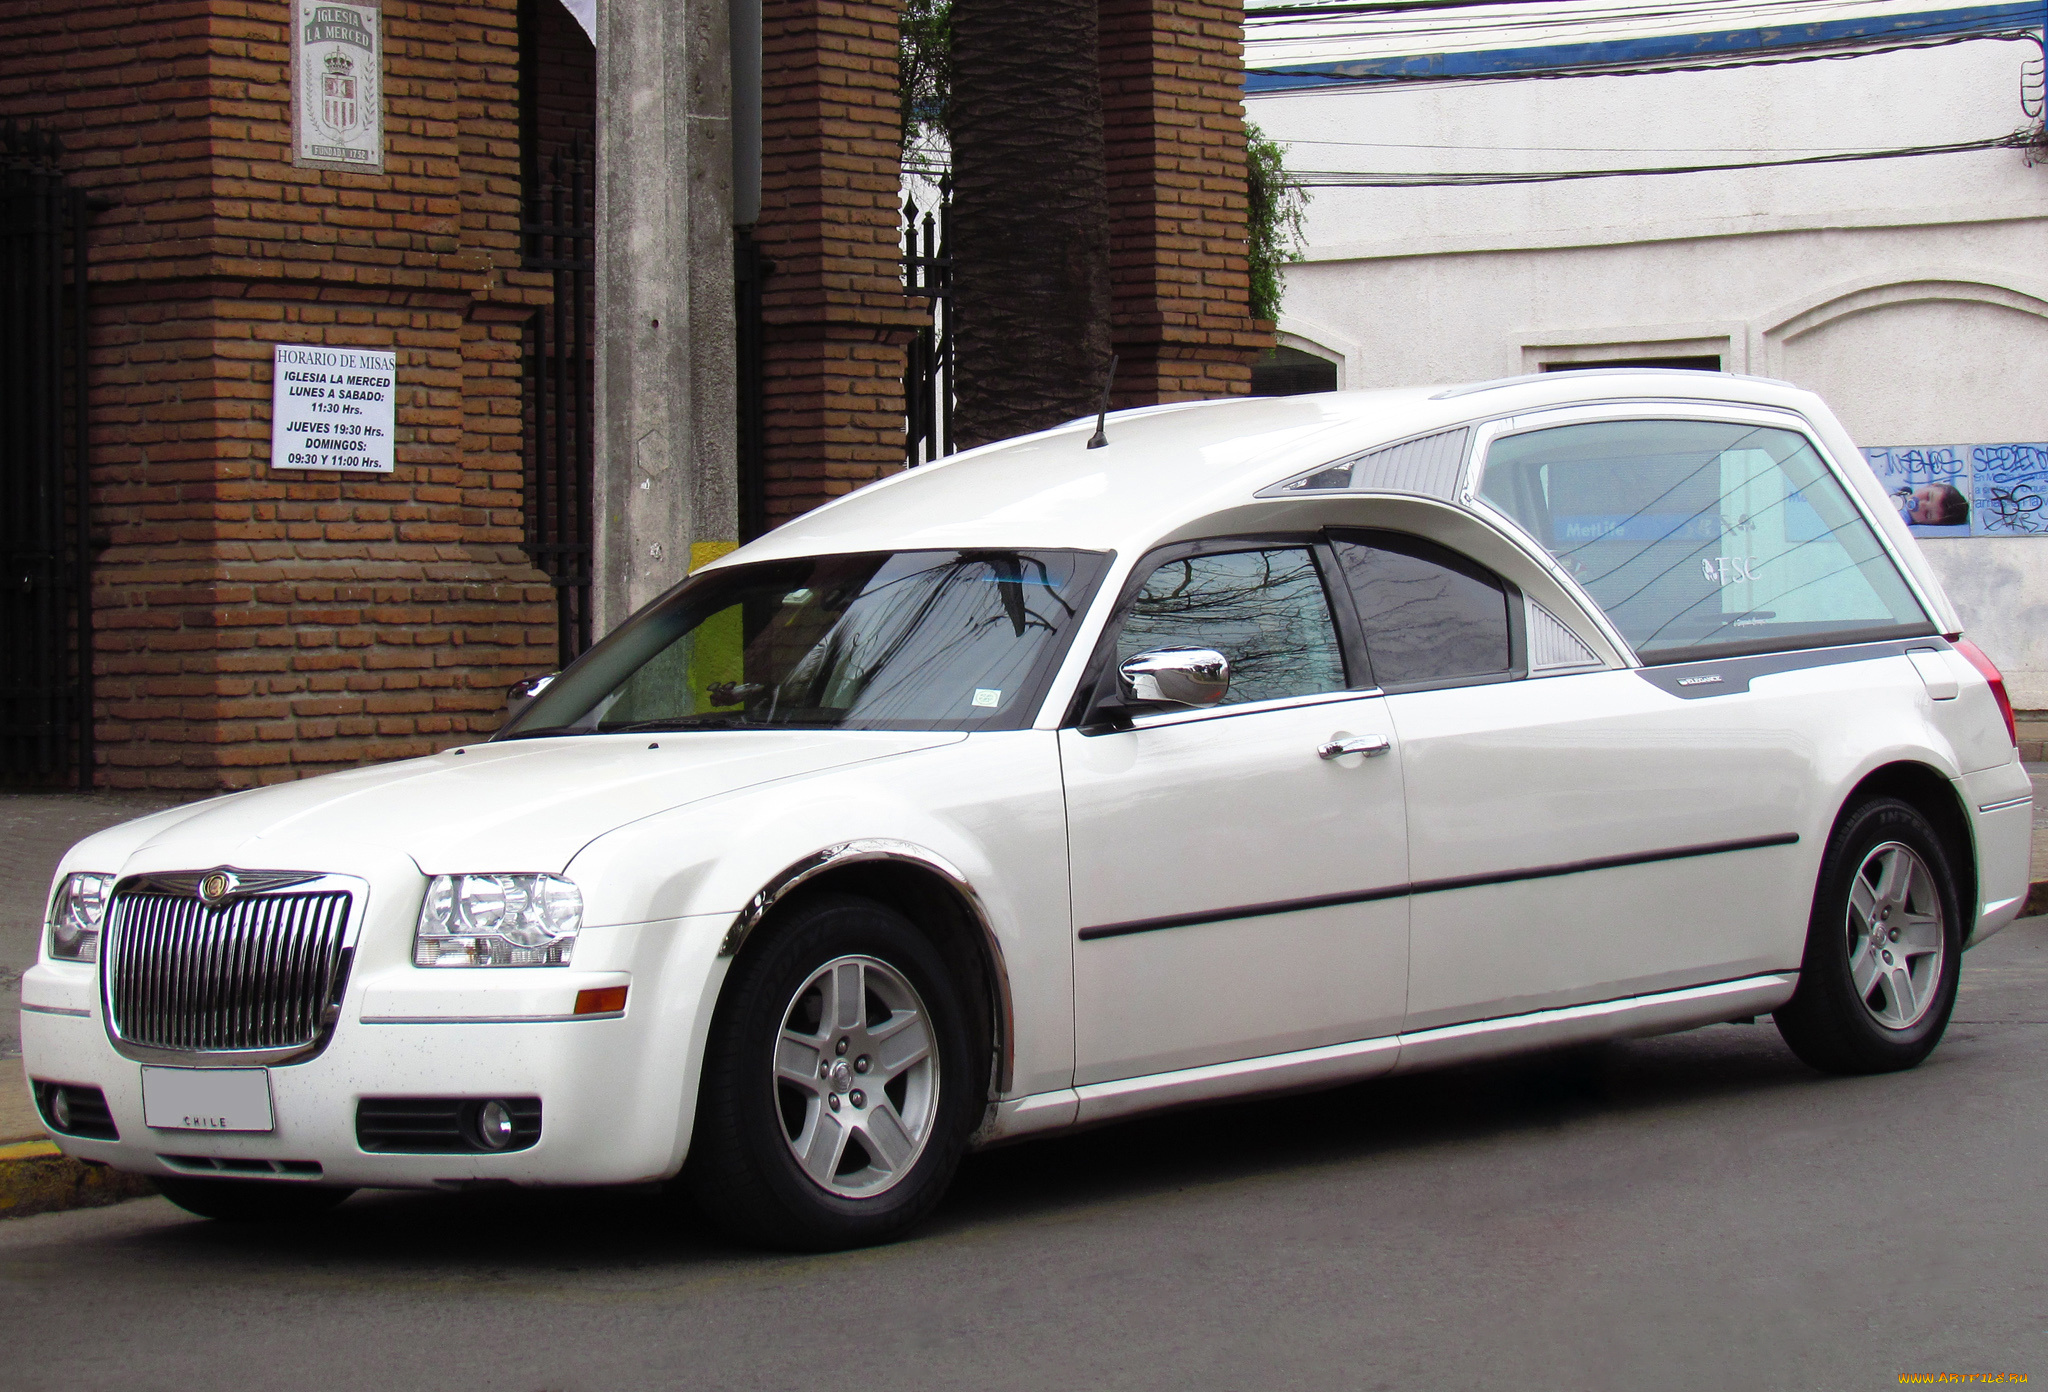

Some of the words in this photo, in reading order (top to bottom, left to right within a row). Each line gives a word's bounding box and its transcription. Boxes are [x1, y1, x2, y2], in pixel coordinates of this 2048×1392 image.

[317, 9, 360, 28] IGLESIA
[306, 27, 321, 42] LA
[326, 26, 369, 47] MERCED
[313, 146, 347, 158] FUNDADA
[349, 149, 367, 160] 1752
[277, 350, 337, 367] HORARIO
[340, 354, 357, 369] DE
[360, 356, 395, 371] MISAS
[284, 371, 327, 383] IGLESIA
[330, 374, 344, 385] LA
[346, 375, 391, 388] MERCED
[289, 386, 325, 398] LUNES
[328, 388, 335, 399] A
[338, 389, 385, 402] SABADO:
[311, 402, 340, 413] 11:30
[342, 404, 363, 415] Hrs.
[286, 421, 331, 434] JUEVES
[333, 423, 361, 436] 19:30
[364, 425, 385, 437] Hrs.
[305, 438, 367, 452] DOMINGOS:
[288, 453, 318, 465] 09:30
[321, 455, 329, 465] Y
[331, 456, 359, 467] 11:00
[361, 457, 382, 468] Hrs.
[1566, 520, 1625, 538] MetLife
[184, 1116, 227, 1128] CHILE
